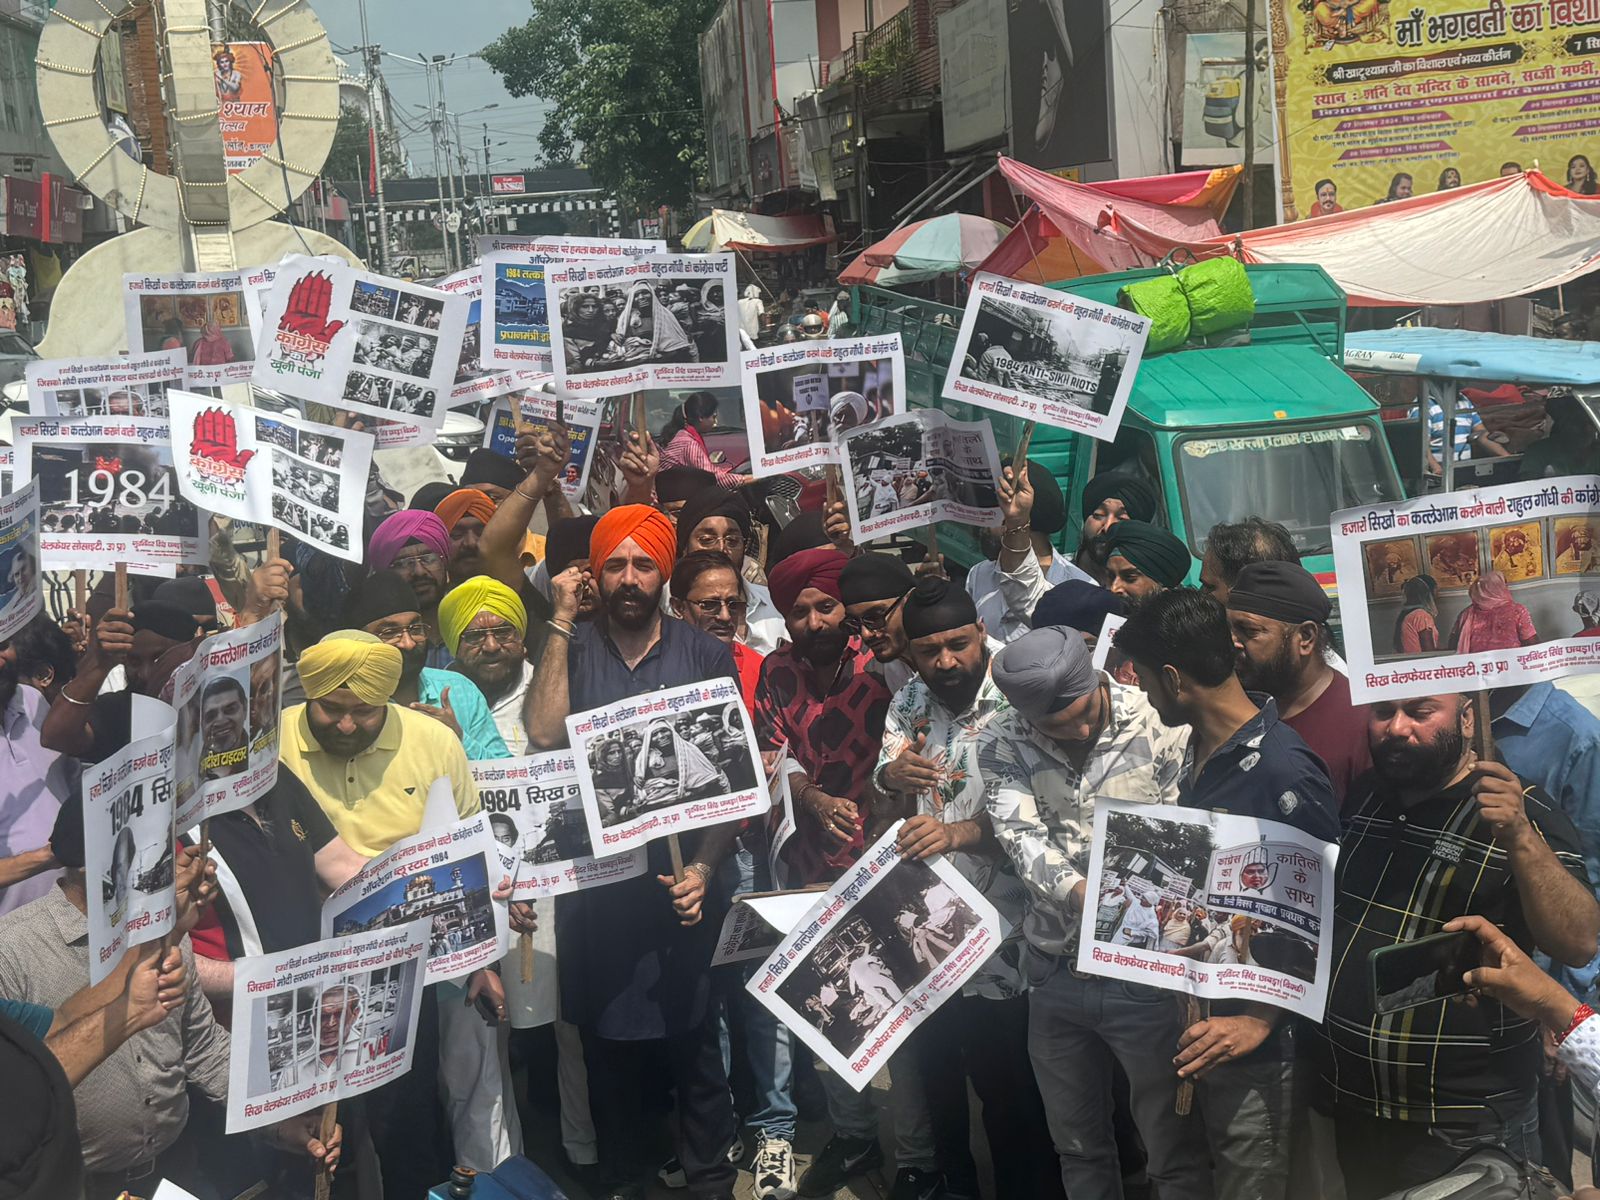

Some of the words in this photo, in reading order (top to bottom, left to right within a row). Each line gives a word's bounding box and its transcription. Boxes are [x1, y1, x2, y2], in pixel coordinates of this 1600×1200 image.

[1396, 8, 1424, 47] माँ
[1428, 0, 1507, 41] भगवती
[1511, 2, 1543, 31] का
[1363, 85, 1388, 99] शनि
[1456, 75, 1469, 89] के
[224, 102, 270, 116] श्याम
[995, 356, 1020, 371] 1984
[1021, 363, 1070, 386] ANTI-SIKH
[1070, 376, 1098, 393] RIOTS
[64, 468, 176, 518] 1984
[1341, 516, 1367, 536] हजारों
[1368, 509, 1395, 531] सिखों
[1397, 516, 1410, 527] का
[1411, 503, 1458, 526] कत्लेआम
[1485, 497, 1506, 516] वाली
[1507, 495, 1533, 518] राहुल
[1560, 487, 1574, 505] की
[1365, 673, 1390, 689] सिख
[1391, 667, 1433, 684] वेलफेयर
[110, 783, 144, 836] 1984
[479, 788, 521, 813] 1984
[526, 784, 565, 805] सिख
[408, 858, 430, 871] स्टार
[431, 851, 449, 864] 1984
[1221, 868, 1232, 877] का
[1294, 870, 1308, 883] के
[1284, 886, 1316, 908] साथ
[1092, 947, 1112, 963] सिख
[1112, 954, 1149, 971] वेलफेयर
